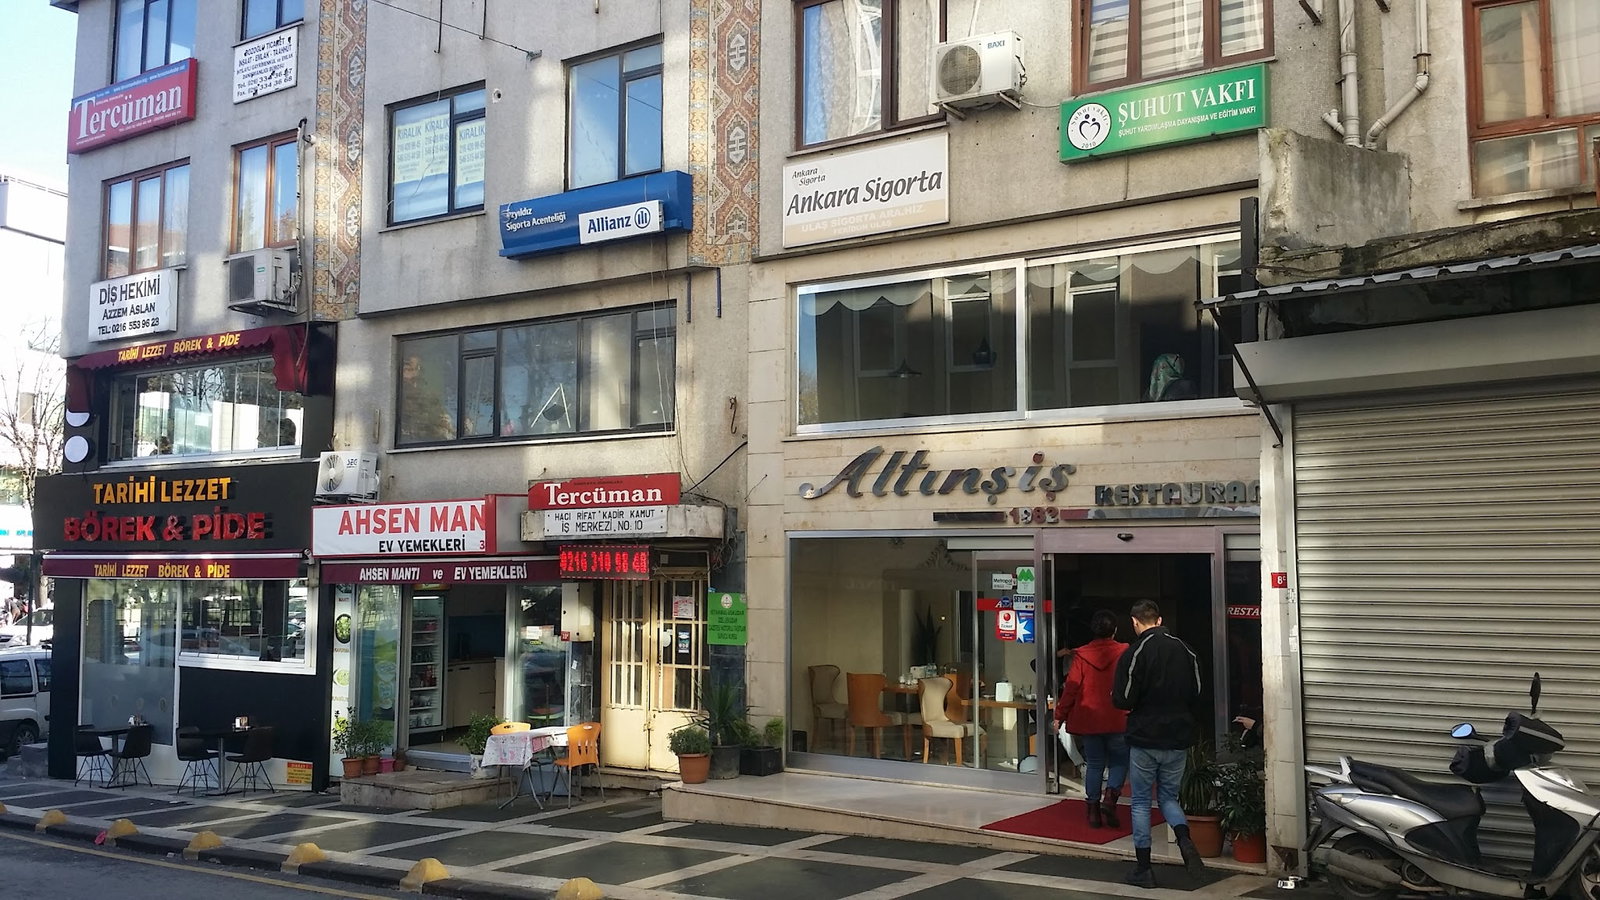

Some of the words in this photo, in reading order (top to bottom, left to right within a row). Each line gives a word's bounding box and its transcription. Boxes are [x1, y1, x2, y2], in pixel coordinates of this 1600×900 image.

[988, 40, 1005, 49] BAXI
[1118, 92, 1186, 127] ŞUHUT
[1191, 78, 1256, 108] VAKFI
[73, 85, 182, 140] Tercüman
[1118, 126, 1136, 137] ŞUHUT
[1177, 115, 1209, 126] DAYANIŞMA
[1209, 112, 1218, 120] VE
[1218, 108, 1239, 119] EĞİTİM
[1239, 105, 1256, 116] VAKFI
[792, 167, 818, 179] Ankara
[799, 174, 826, 186] Sigorta
[787, 186, 859, 216] Ankara
[862, 170, 943, 203] Sigorta
[506, 219, 531, 232] Sigorta
[531, 211, 566, 226] Acenteliği
[587, 214, 631, 234] Allianz
[801, 221, 828, 232] ULAŞ
[831, 213, 876, 228] SİGORTA
[99, 284, 117, 306] DİŞ
[120, 274, 160, 301] HEKİMİ
[102, 307, 128, 320] AZZEM
[129, 302, 156, 315] ASLAN
[128, 321, 140, 330] 553
[142, 319, 150, 328] 96
[151, 317, 160, 327] 23
[118, 346, 139, 361] TARİHİ
[141, 344, 167, 358] LEZZET
[173, 339, 202, 353] BÖREK
[206, 337, 213, 349] &
[218, 332, 240, 347] PİDE
[799, 446, 1077, 504] Altınşiş
[93, 475, 155, 504] TARİHİ
[160, 477, 232, 503] LEZZET
[543, 482, 662, 506] Tercüman
[64, 510, 156, 542] BÖREK
[161, 515, 184, 541] &
[192, 505, 266, 540] PİDE
[338, 506, 420, 535] AHSEN
[554, 513, 571, 521] HACI
[577, 510, 596, 520] RİFAT
[602, 508, 625, 519] KADİR
[630, 509, 655, 519] KAMUT
[1009, 506, 1060, 524] 1982
[562, 520, 570, 533] İŞ
[634, 520, 643, 530] 10
[378, 540, 393, 553] EV
[397, 534, 466, 552] YEMEKLERİ
[94, 562, 117, 577] TARİHİ
[122, 564, 149, 577] LEZZET
[158, 562, 189, 577] BÖREK
[194, 565, 201, 577] &
[207, 562, 230, 578] PİDE
[560, 551, 588, 572] 0216
[359, 567, 389, 581] AHSEN
[391, 566, 420, 580] MANTI
[432, 568, 443, 580] ve
[454, 567, 468, 580] EV
[469, 562, 527, 580] YEMEKLERİ
[1013, 595, 1034, 603] SETCARD
[1227, 607, 1261, 616] RESTA
